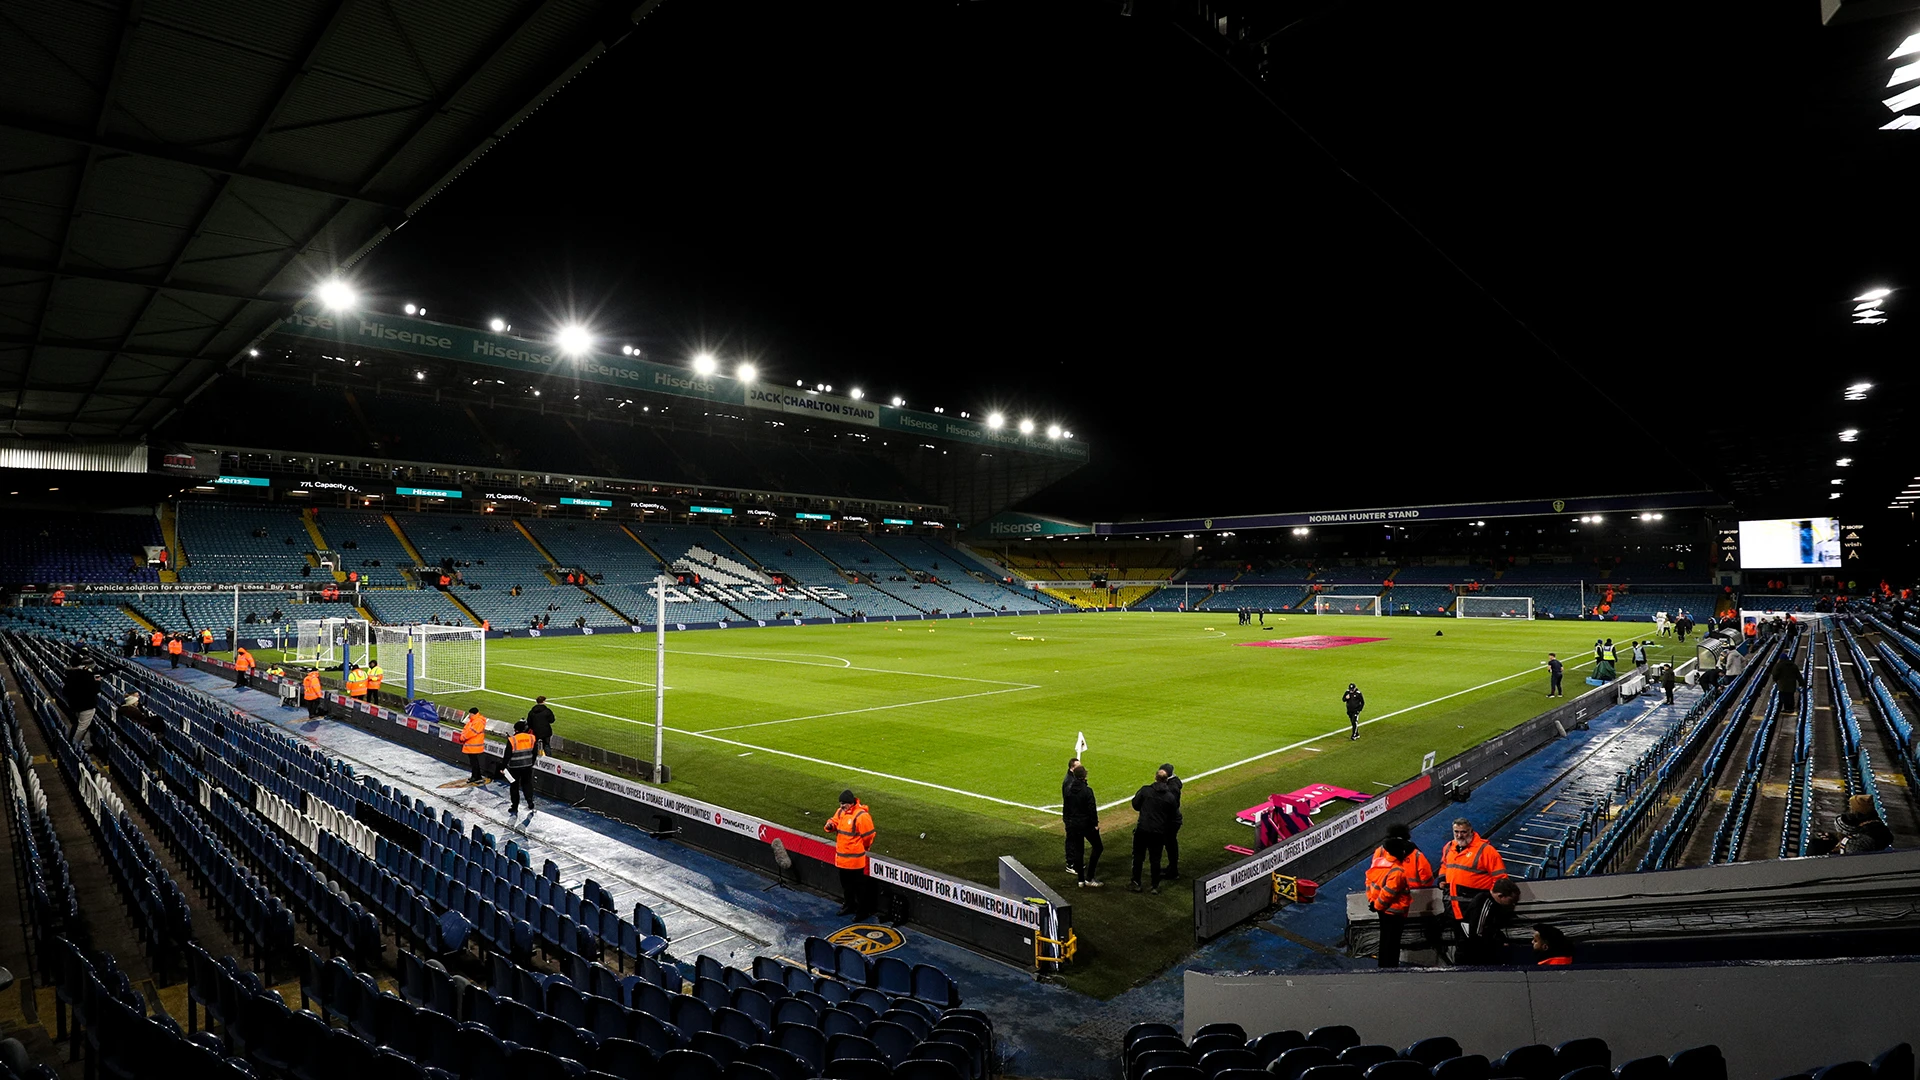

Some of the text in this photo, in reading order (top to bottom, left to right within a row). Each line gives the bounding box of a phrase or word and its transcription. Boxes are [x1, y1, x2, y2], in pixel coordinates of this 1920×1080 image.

[359, 321, 452, 348] Hisense
[472, 340, 552, 365] Hisense
[571, 359, 639, 381] Hisense
[654, 372, 715, 393] Hisense
[751, 390, 875, 419] JACK CHARLTON STAND
[900, 416, 938, 431] Hisense
[946, 424, 981, 438] Hisense
[988, 431, 1019, 445] Hisense
[315, 482, 347, 491] Capacity
[413, 489, 447, 497] Hisense
[1309, 510, 1419, 522] NORMAN HUNTER STAND
[990, 523, 1041, 533] Hisense
[646, 793, 663, 807] STORAGE
[664, 799, 675, 810] LAND
[722, 817, 754, 833] TOWNGATE PLC
[1305, 831, 1322, 850] STORAGE
[1322, 826, 1332, 841] LAND
[874, 863, 884, 876] ON
[885, 865, 899, 881] THE
[900, 871, 933, 892] LOOKOUT
[936, 882, 951, 898] FOR
[952, 887, 958, 900] A
[1217, 880, 1226, 890] PLC
